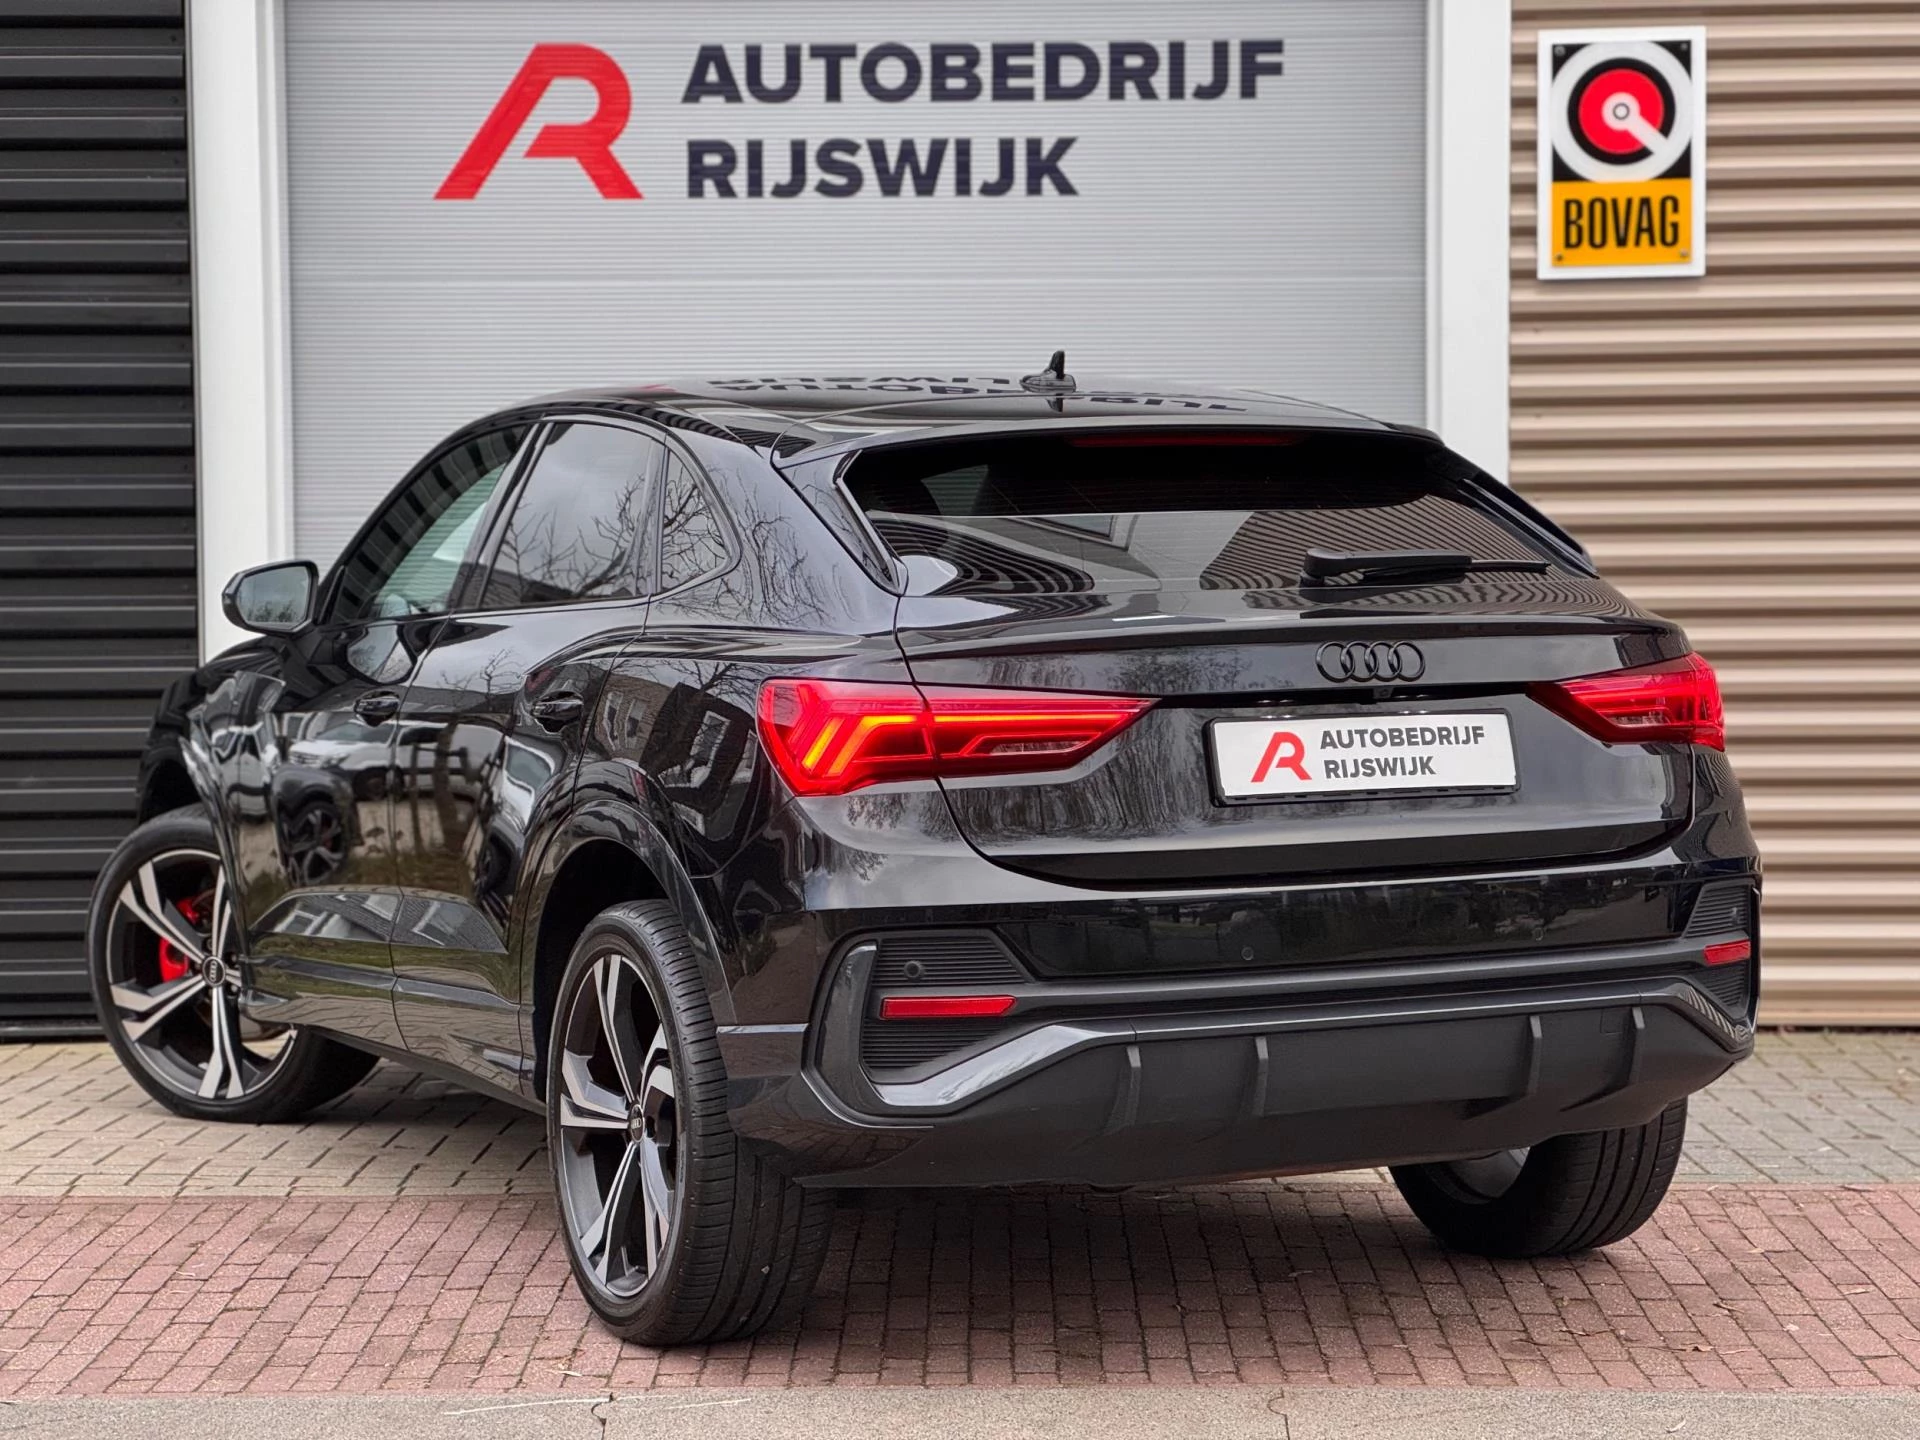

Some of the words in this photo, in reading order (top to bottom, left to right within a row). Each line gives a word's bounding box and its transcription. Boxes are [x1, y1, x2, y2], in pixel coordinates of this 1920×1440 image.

[682, 40, 1284, 103] AUTOBEDRIJF
[686, 137, 1078, 198] RIJSWIJK
[1564, 195, 1680, 249] BOVAG
[1320, 726, 1486, 749] AUTOBEDRIJF
[1324, 756, 1436, 779] RIJSWIJK
